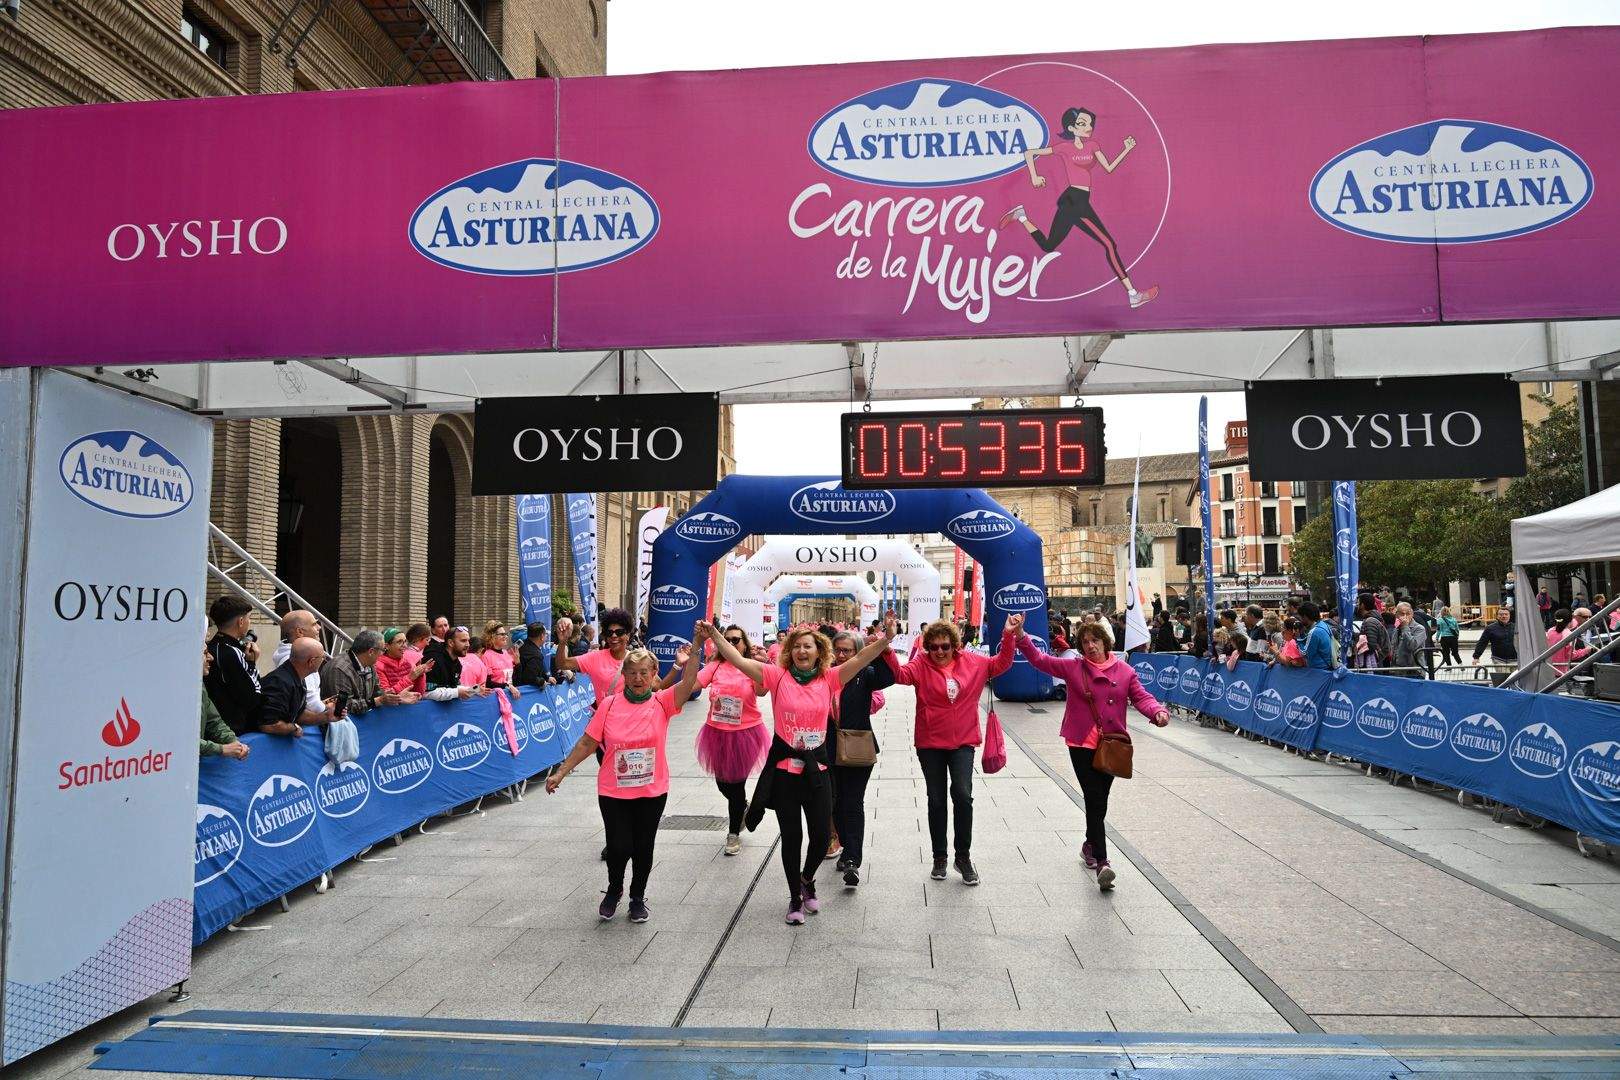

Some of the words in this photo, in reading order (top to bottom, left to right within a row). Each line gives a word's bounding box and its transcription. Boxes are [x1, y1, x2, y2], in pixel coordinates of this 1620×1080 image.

[863, 116, 938, 129] CENTRAL
[945, 113, 1021, 125] LECHERA
[827, 121, 1028, 161] ASTURIANA
[1374, 162, 1462, 177] CENTRAL
[1470, 158, 1561, 172] LECHERA
[467, 199, 544, 213] CENTRAL
[552, 195, 632, 208] LECHERA
[1332, 169, 1573, 215] ASTURIANA
[788, 183, 985, 238] Carrera
[107, 216, 288, 261] OYSHO
[428, 206, 640, 248] ASTURIANA
[836, 243, 873, 279] de
[882, 239, 908, 279] la
[902, 228, 1062, 324] Mujer
[1230, 427, 1248, 438] TIB
[1290, 411, 1483, 450] OYSHO
[513, 426, 683, 462] OYSHO
[70, 451, 185, 503] ASTURIANA
[94, 453, 138, 470] CENTRAL
[142, 463, 182, 479] LECHERA
[798, 493, 888, 513] ASTURIANA
[680, 522, 735, 536] ASTURIANA
[953, 522, 1011, 534] ASTURIANA
[796, 546, 877, 563] OYSHO
[996, 594, 1042, 605] ASTURIANA
[1325, 707, 1351, 721] TURIANA
[1358, 709, 1395, 731] ASTURIANA
[498, 728, 527, 746] ASIANA
[1403, 717, 1443, 740] ASTURIANA
[1453, 727, 1501, 753] ASTURIANA
[441, 739, 488, 764] ASTURIANA
[1512, 737, 1561, 768] ASTURIANA
[58, 749, 172, 790] Santander
[378, 756, 431, 787] ASTURIANA
[321, 778, 368, 808] ASTURIANA
[255, 797, 315, 838] ASTURIANA
